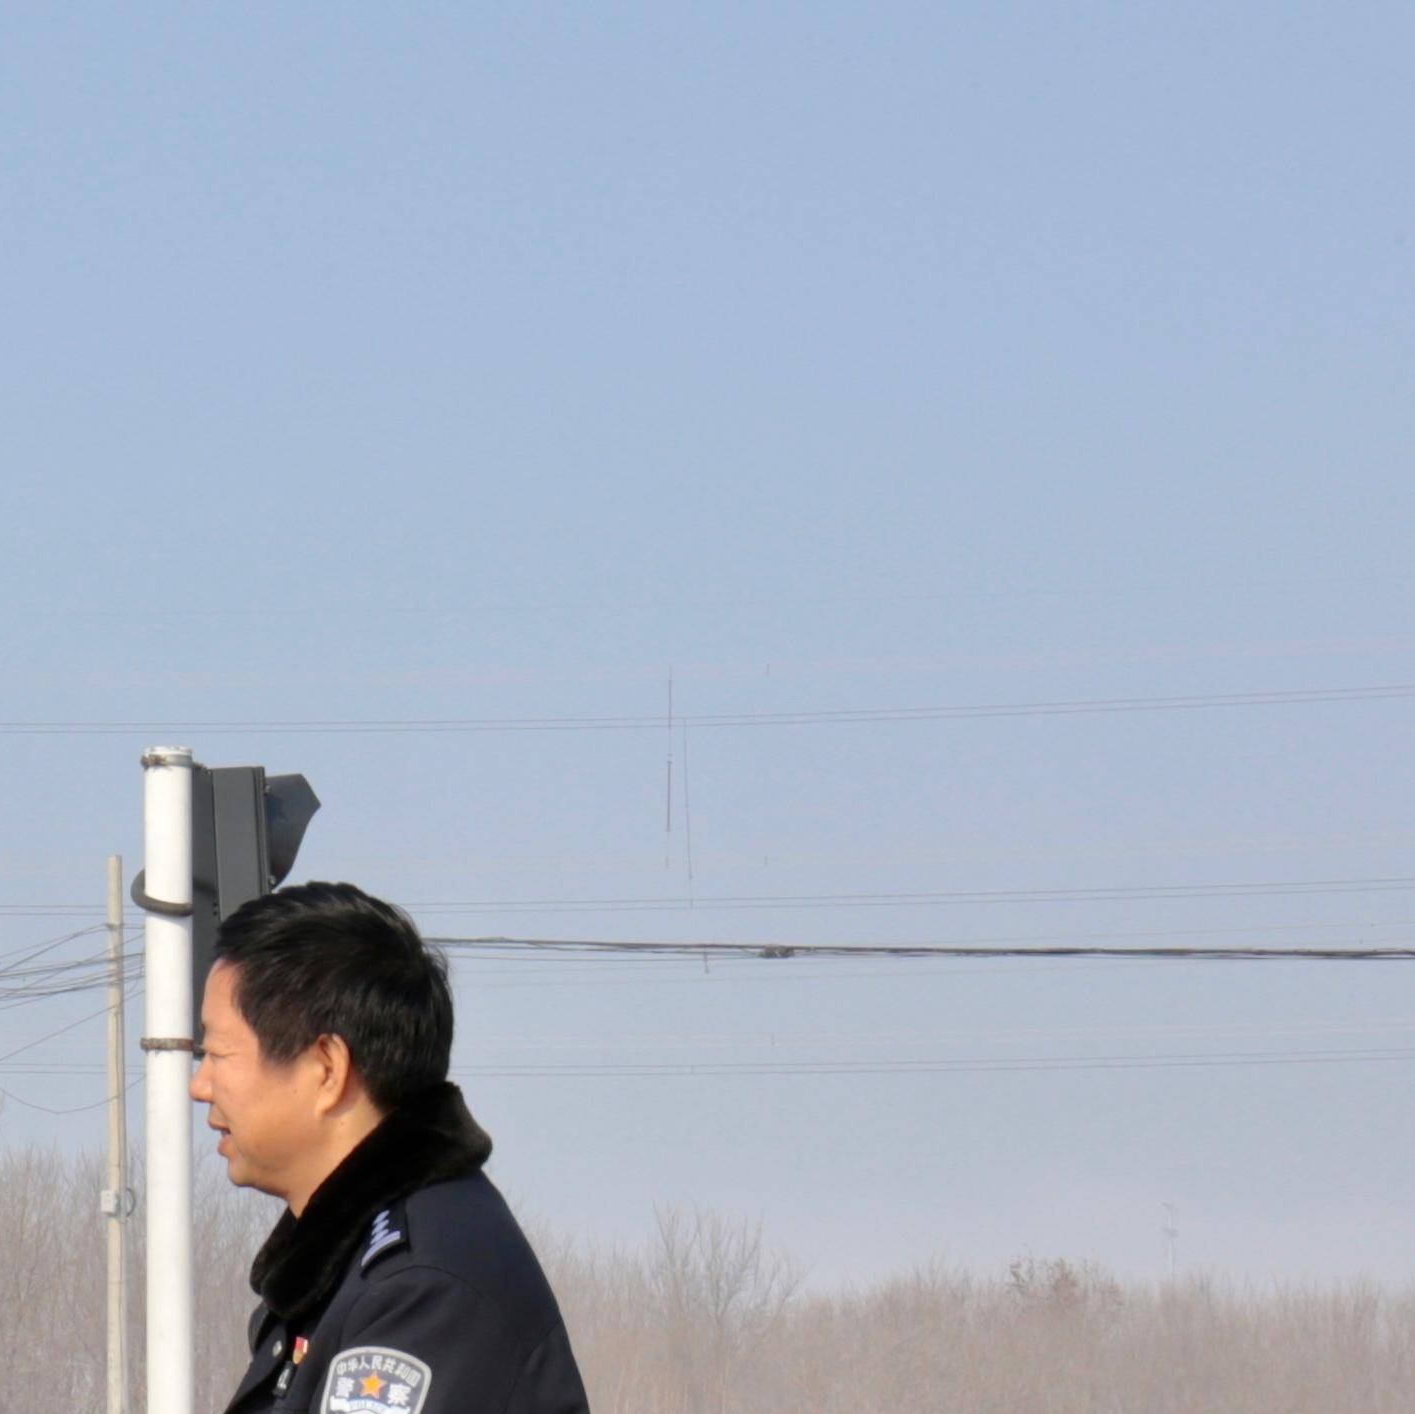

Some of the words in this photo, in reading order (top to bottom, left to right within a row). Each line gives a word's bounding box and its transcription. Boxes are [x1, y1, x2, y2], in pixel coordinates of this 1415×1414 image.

[336, 1354, 422, 1388] 中华人民共和国
